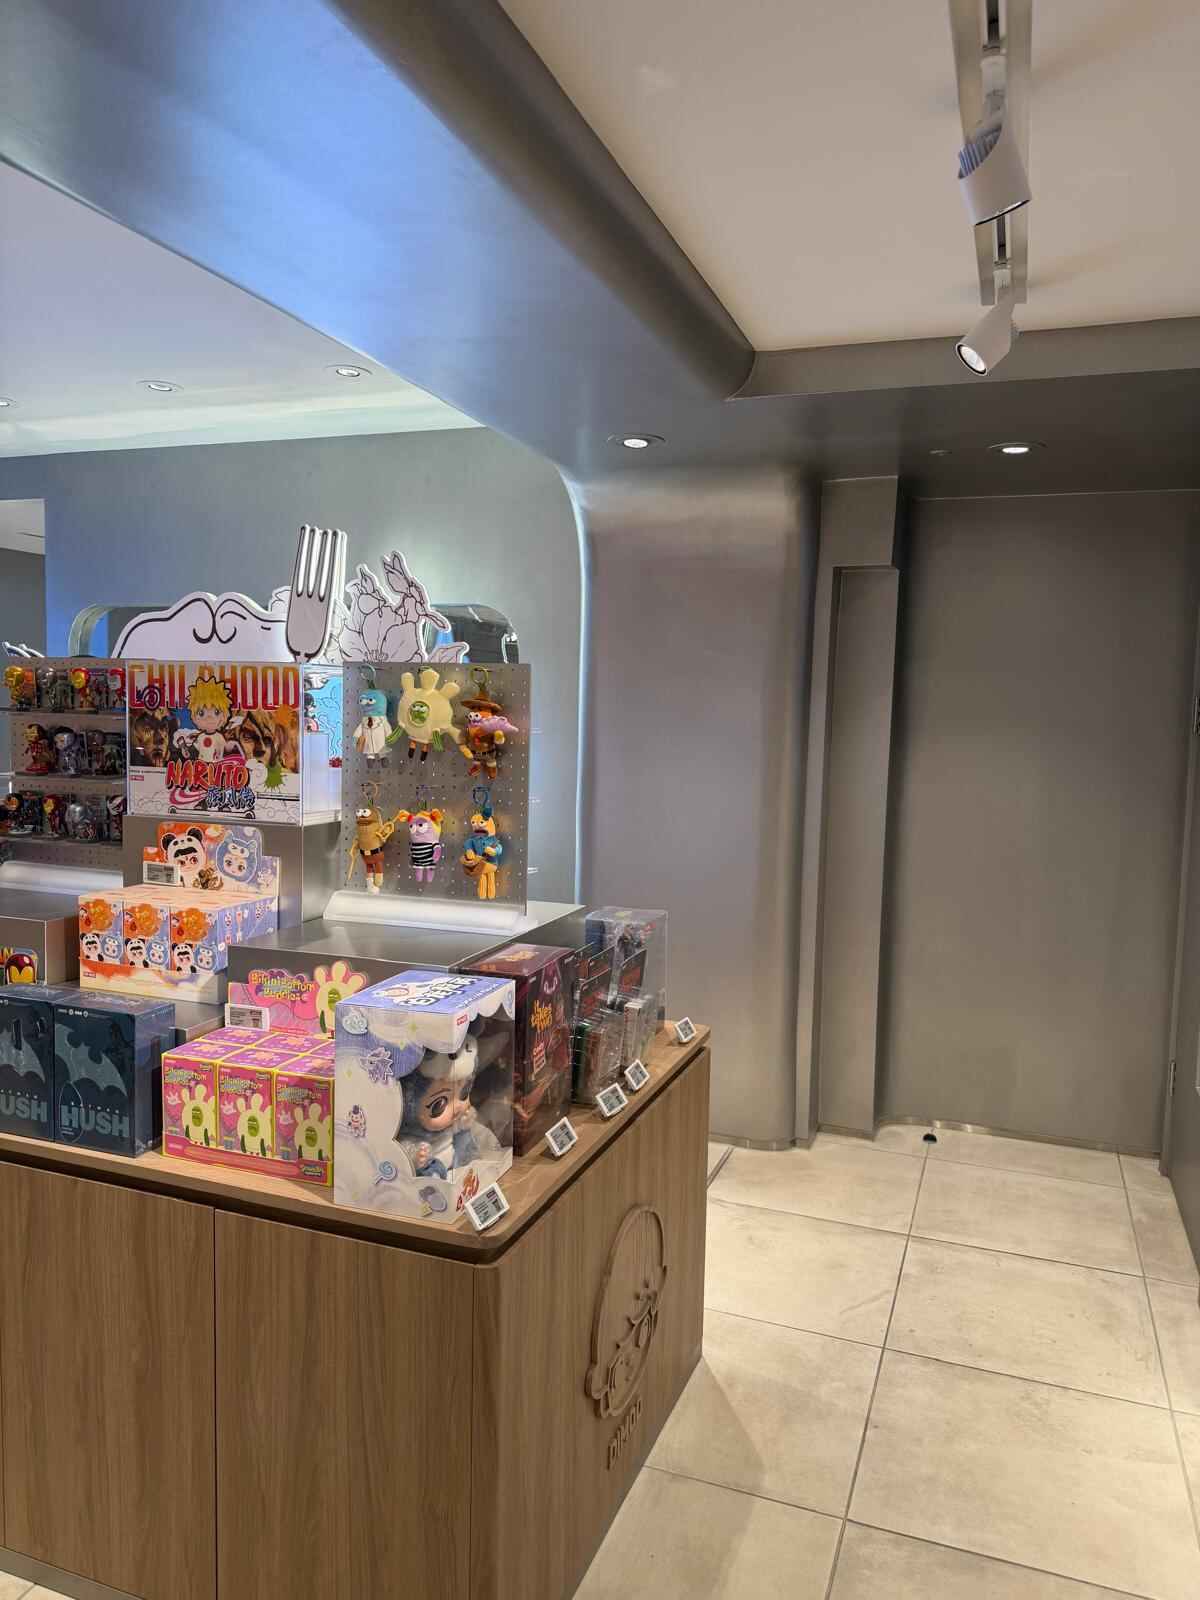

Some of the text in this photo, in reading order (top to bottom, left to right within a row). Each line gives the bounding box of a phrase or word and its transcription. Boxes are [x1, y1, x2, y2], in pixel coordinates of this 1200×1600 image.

[166, 759, 250, 791] NARUTO
[251, 972, 280, 986] Bikini
[263, 987, 301, 1001] Buddies
[0, 1094, 48, 1123] USH
[61, 1104, 130, 1138] HUSH
